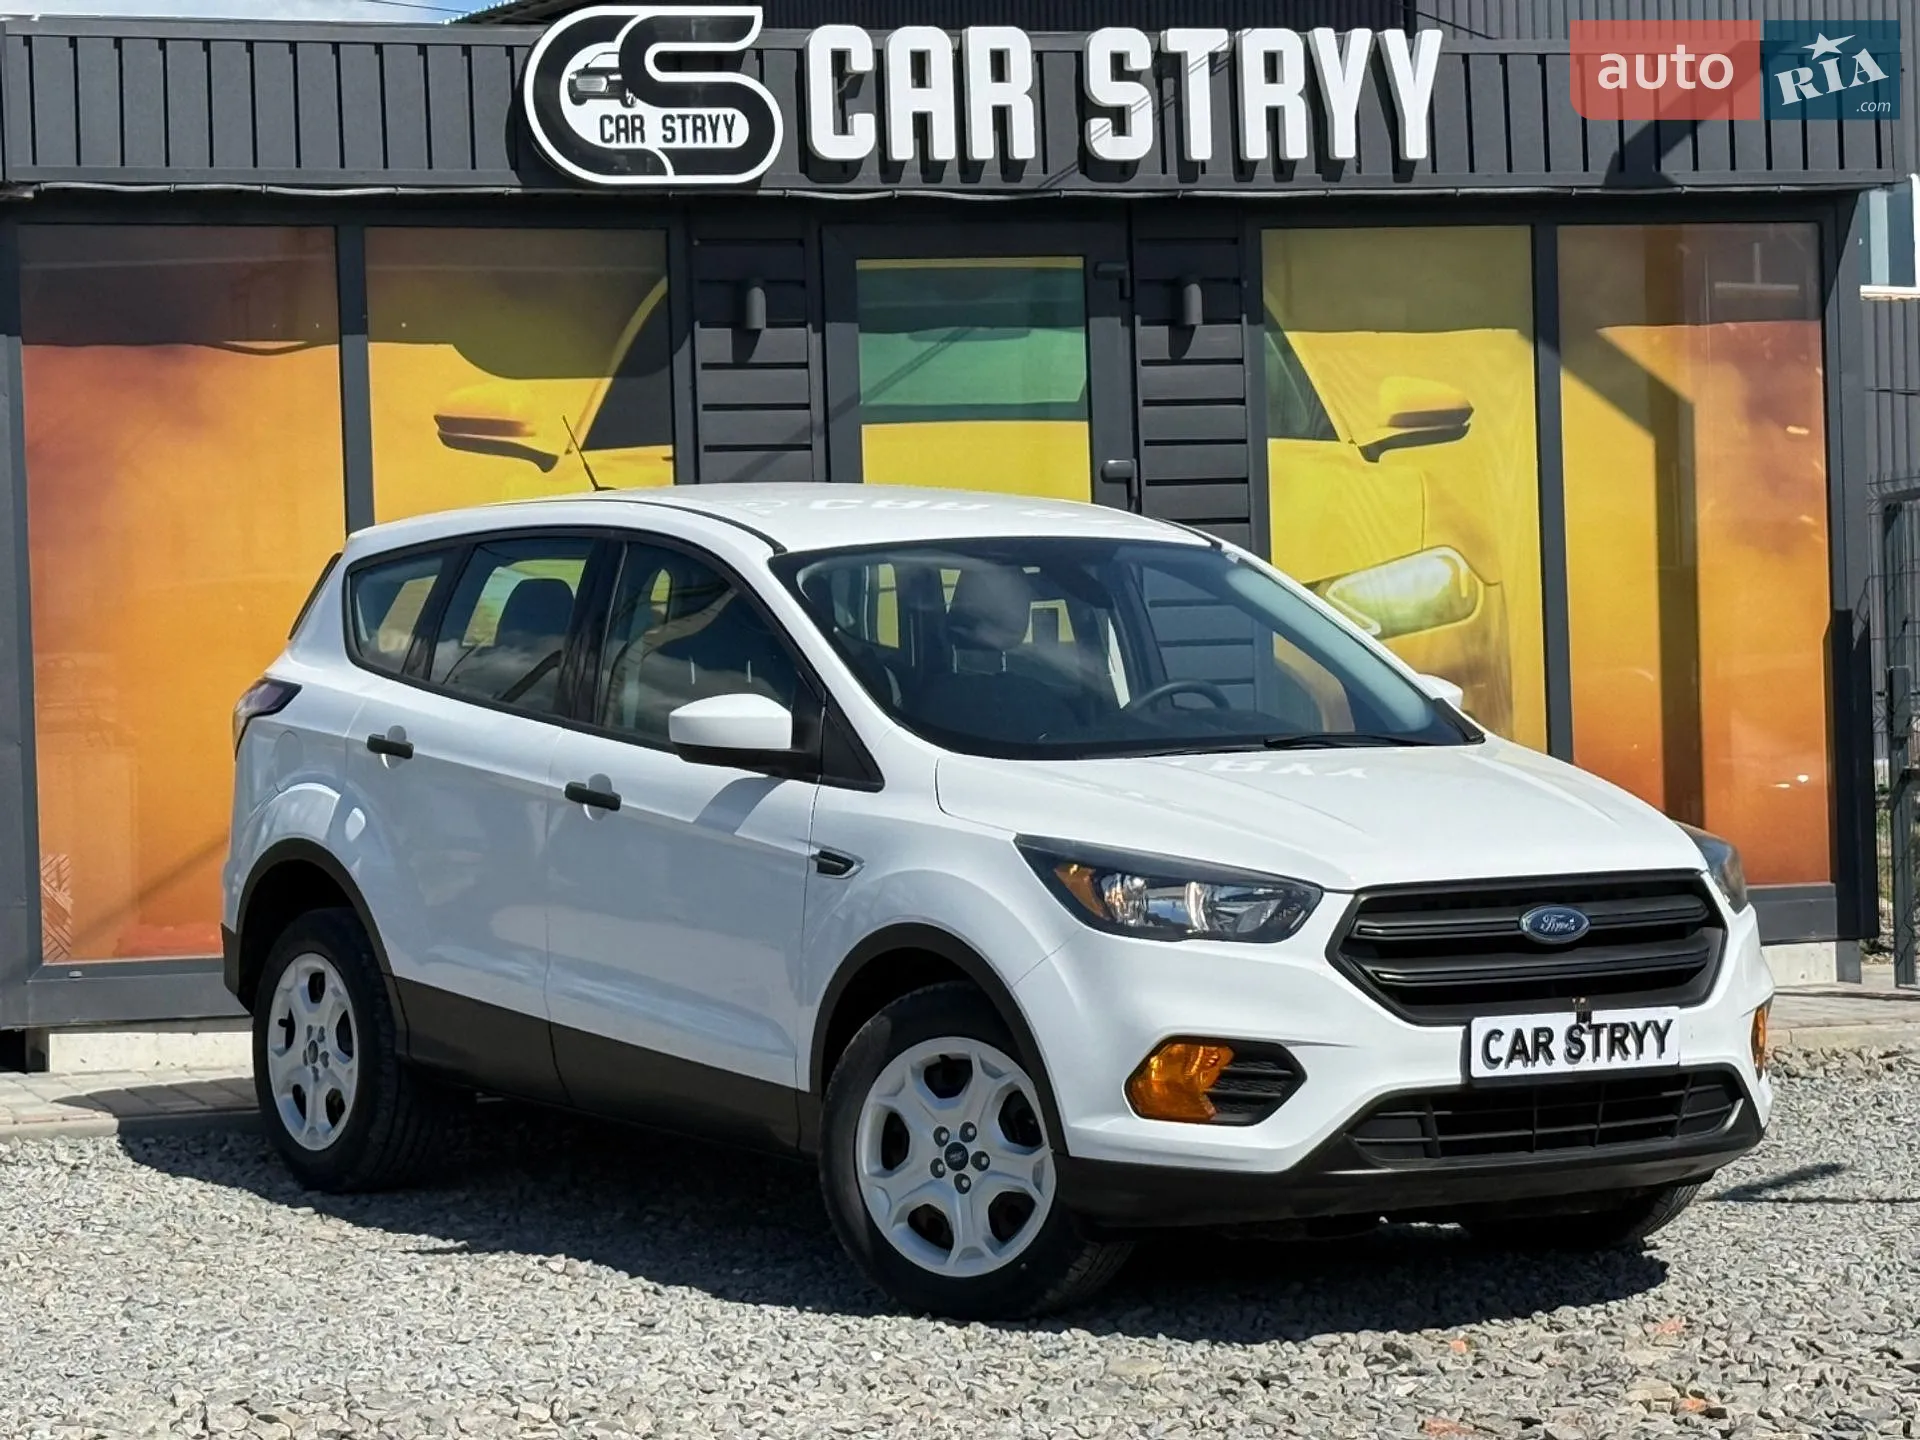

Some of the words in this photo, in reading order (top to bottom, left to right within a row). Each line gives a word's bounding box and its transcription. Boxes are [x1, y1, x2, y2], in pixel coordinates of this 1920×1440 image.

[806, 25, 1036, 161] CAR
[1085, 28, 1443, 161] STRYY
[599, 114, 646, 144] CAR
[661, 113, 736, 144] STRYY
[1482, 1026, 1555, 1069] CAR
[1564, 1019, 1674, 1064] STRYY
